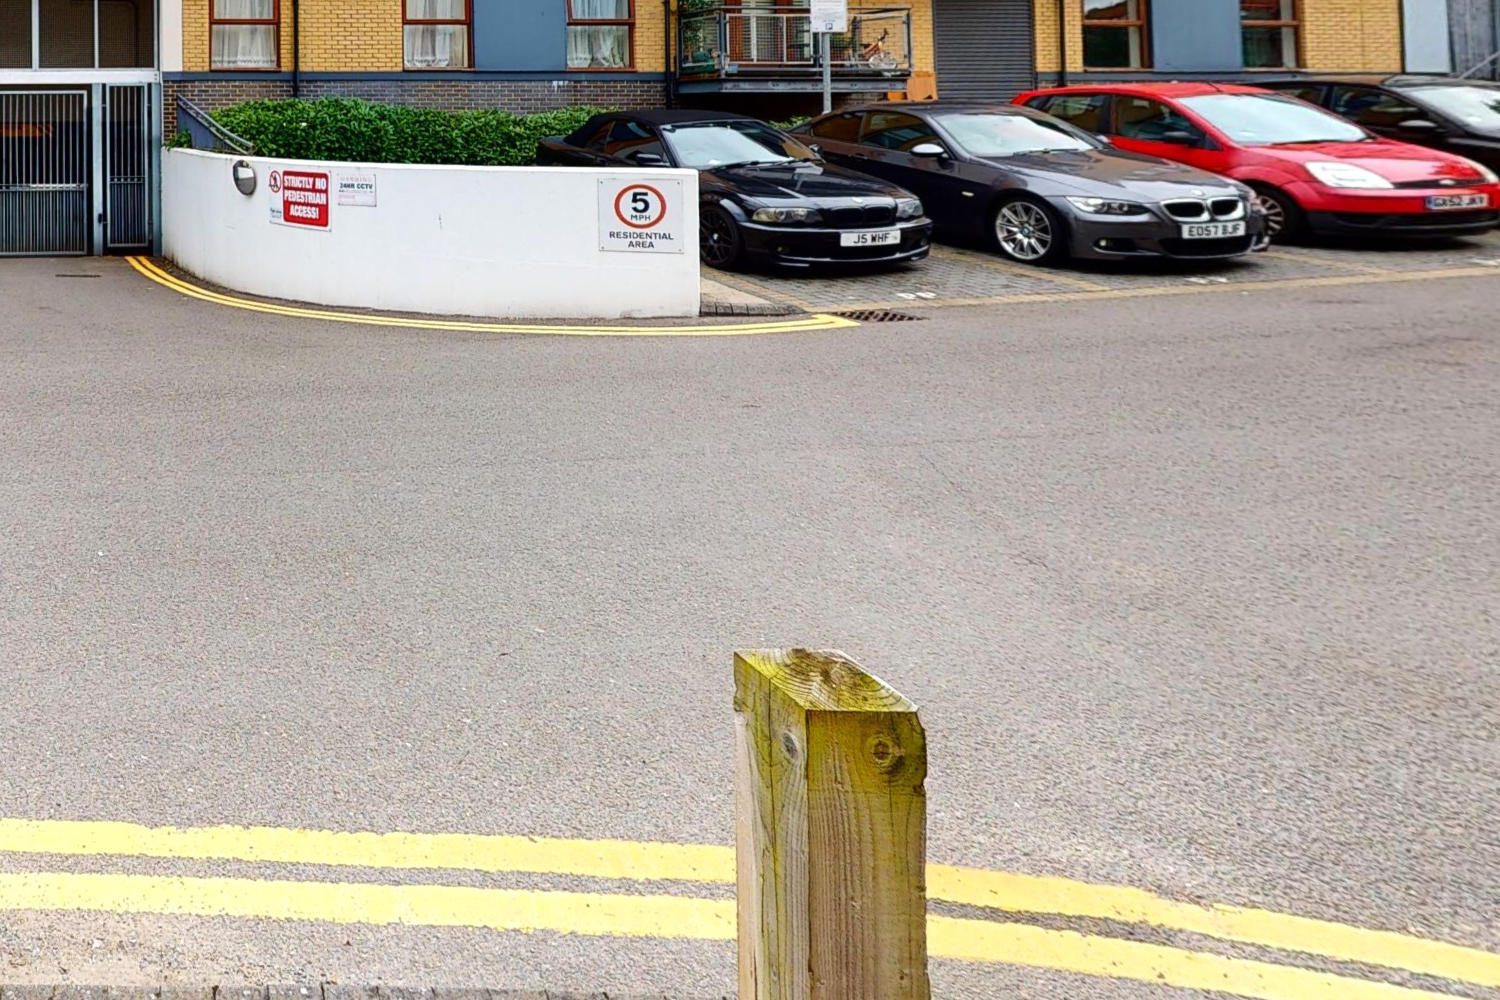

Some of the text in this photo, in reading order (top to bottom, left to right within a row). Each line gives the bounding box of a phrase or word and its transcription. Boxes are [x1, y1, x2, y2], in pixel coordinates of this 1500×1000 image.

[283, 175, 327, 190] STRICTLY NO
[283, 189, 327, 205] PEDESTRIAN
[631, 192, 650, 214] 5
[289, 204, 319, 220] ACCESS!
[609, 231, 674, 241] RESIDENTIAL
[628, 240, 655, 249] AREA
